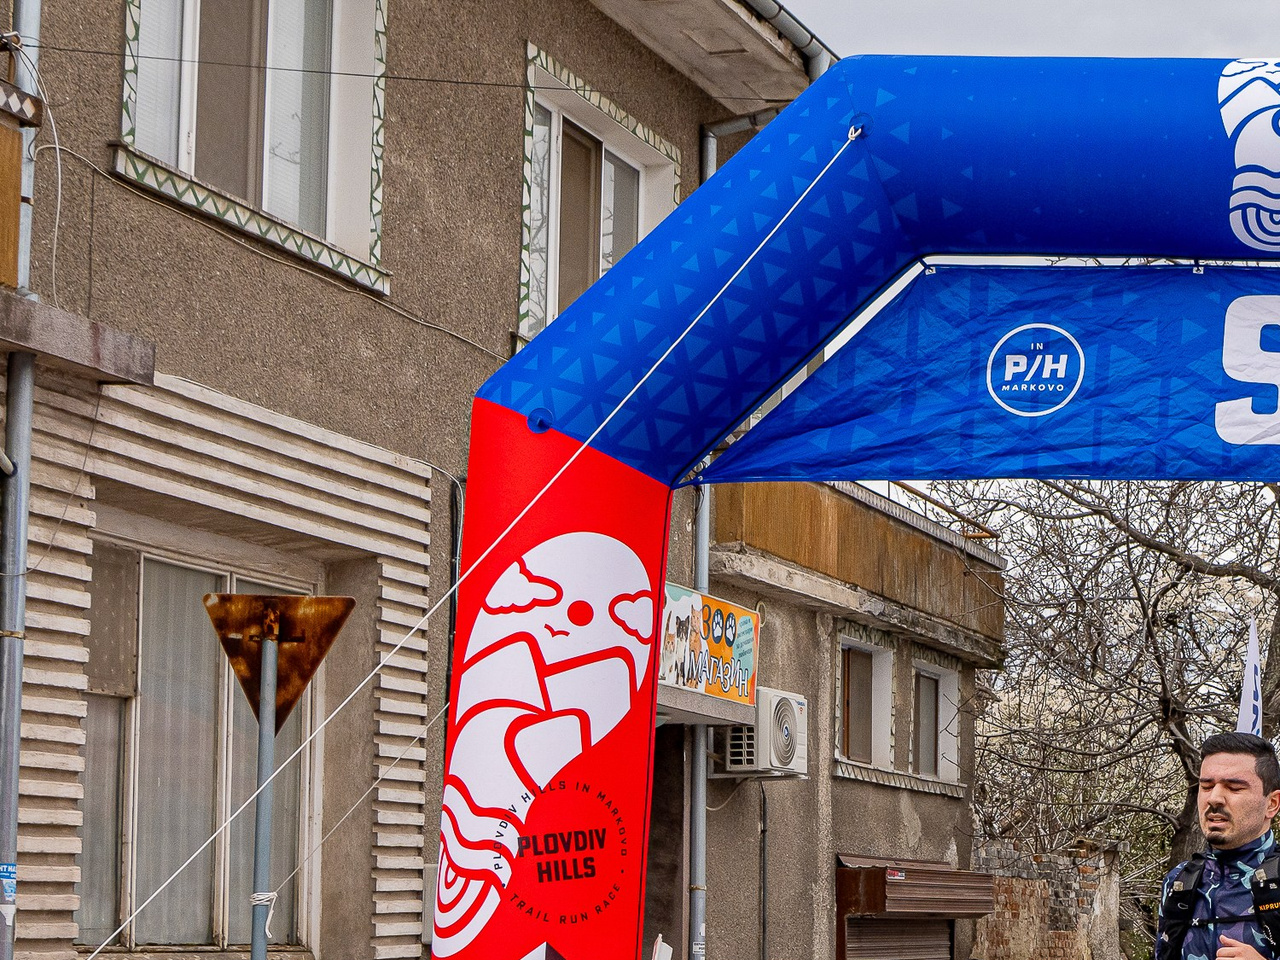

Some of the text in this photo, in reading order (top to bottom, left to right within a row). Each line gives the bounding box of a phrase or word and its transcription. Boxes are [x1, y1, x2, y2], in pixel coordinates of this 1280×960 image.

[1030, 342, 1044, 350] IN
[1004, 354, 1068, 382] P/H
[1001, 383, 1064, 392] MARKOVO
[689, 649, 749, 698] МАГАЗИН
[493, 780, 628, 870] PLOVDIV HILLS IN MARKOVO
[517, 827, 607, 858] PLOVDIV
[537, 856, 597, 883] HILLS
[510, 884, 621, 925] TRAIL RUN RACE
